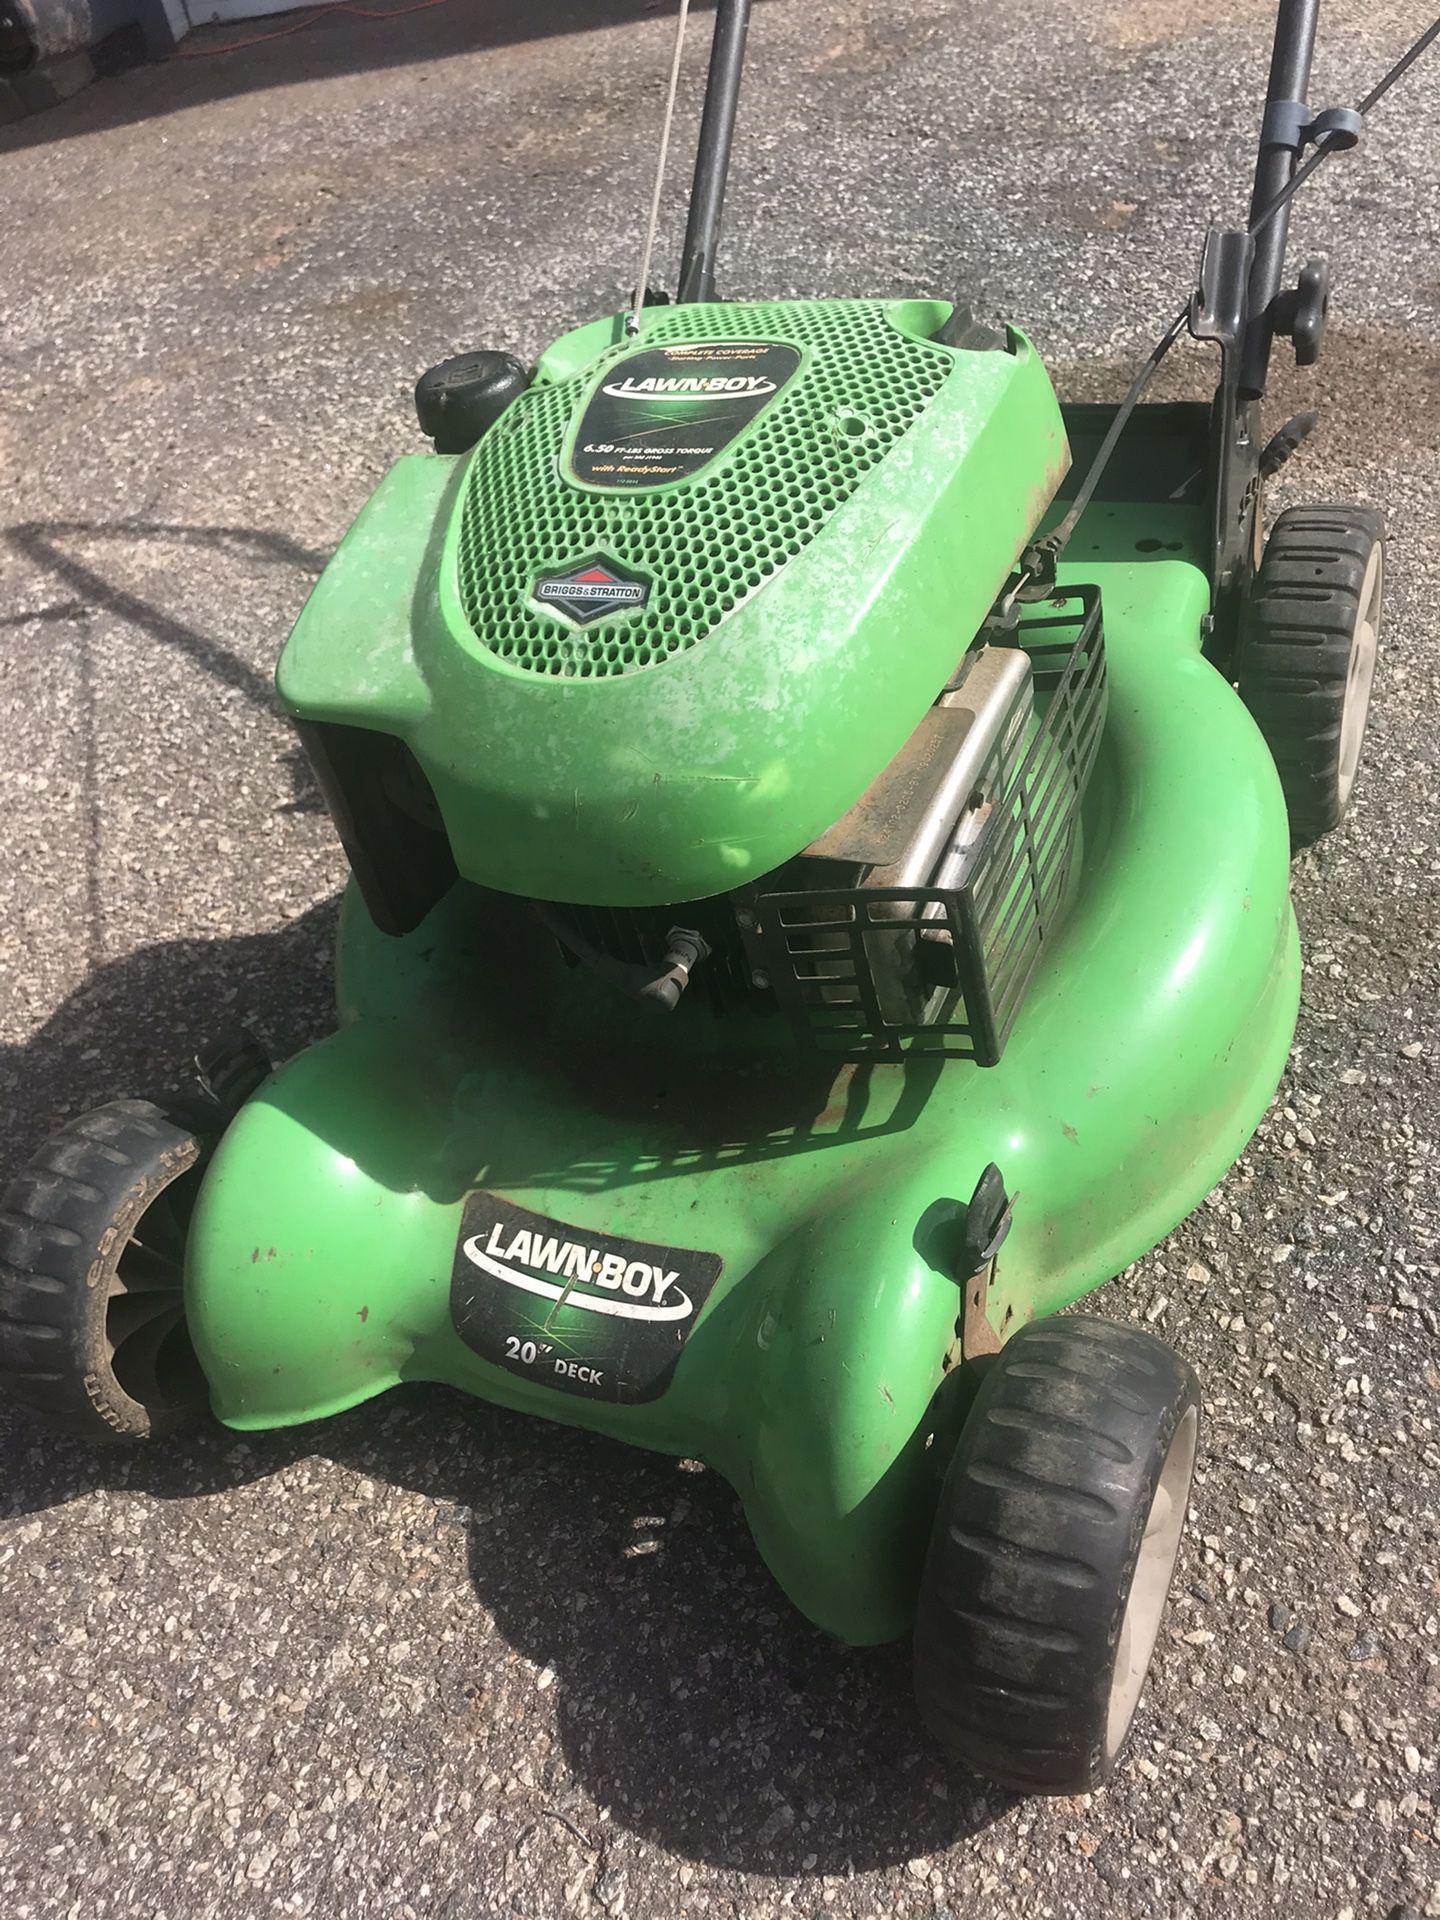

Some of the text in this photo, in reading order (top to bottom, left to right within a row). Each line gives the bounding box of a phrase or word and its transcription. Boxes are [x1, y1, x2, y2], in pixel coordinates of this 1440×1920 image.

[583, 443, 615, 454] 6.50
[643, 447, 675, 455] GROSS
[553, 1358, 604, 1386] DECK
